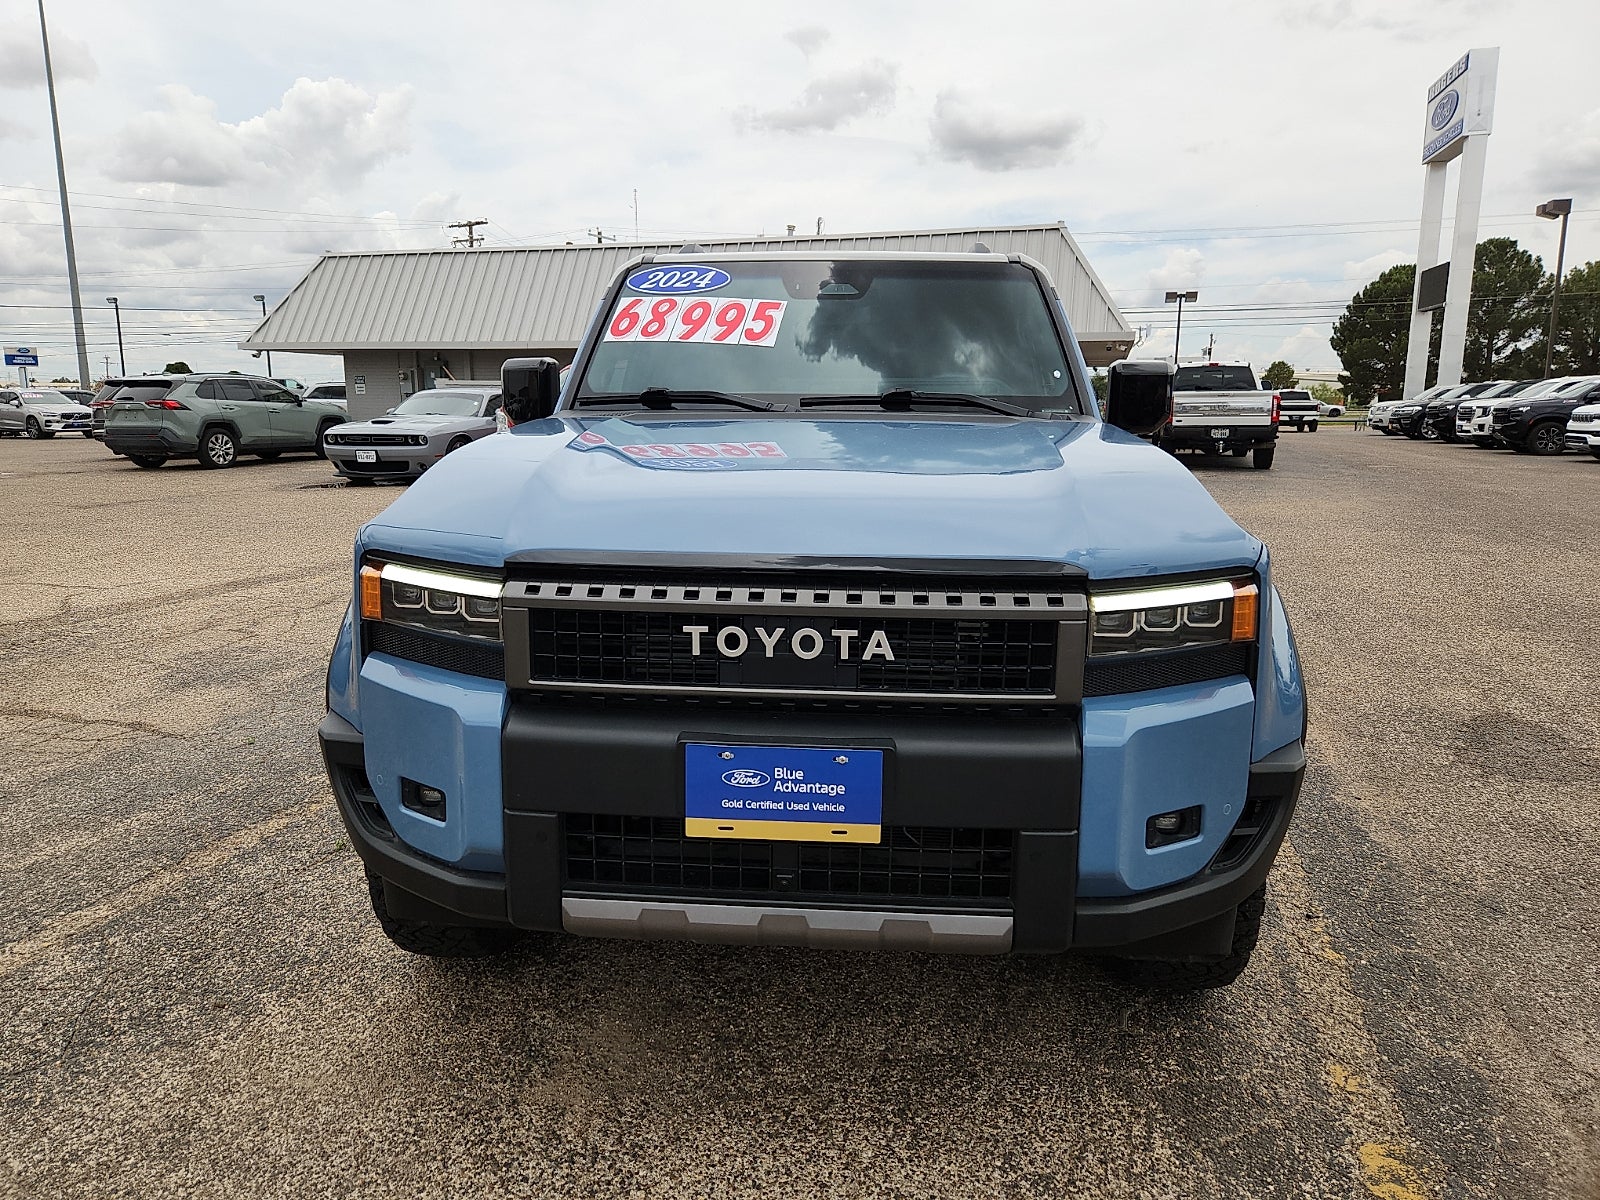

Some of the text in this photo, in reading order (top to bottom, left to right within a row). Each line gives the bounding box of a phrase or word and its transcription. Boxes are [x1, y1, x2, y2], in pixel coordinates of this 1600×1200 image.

[641, 270, 716, 289] 2024
[610, 298, 783, 341] 68995
[682, 625, 895, 661] TOYOTA
[730, 772, 761, 785] Ford
[774, 767, 804, 780] Blue
[773, 781, 846, 796] Advantage
[721, 799, 845, 812] Gold Certified Used Vehicle
